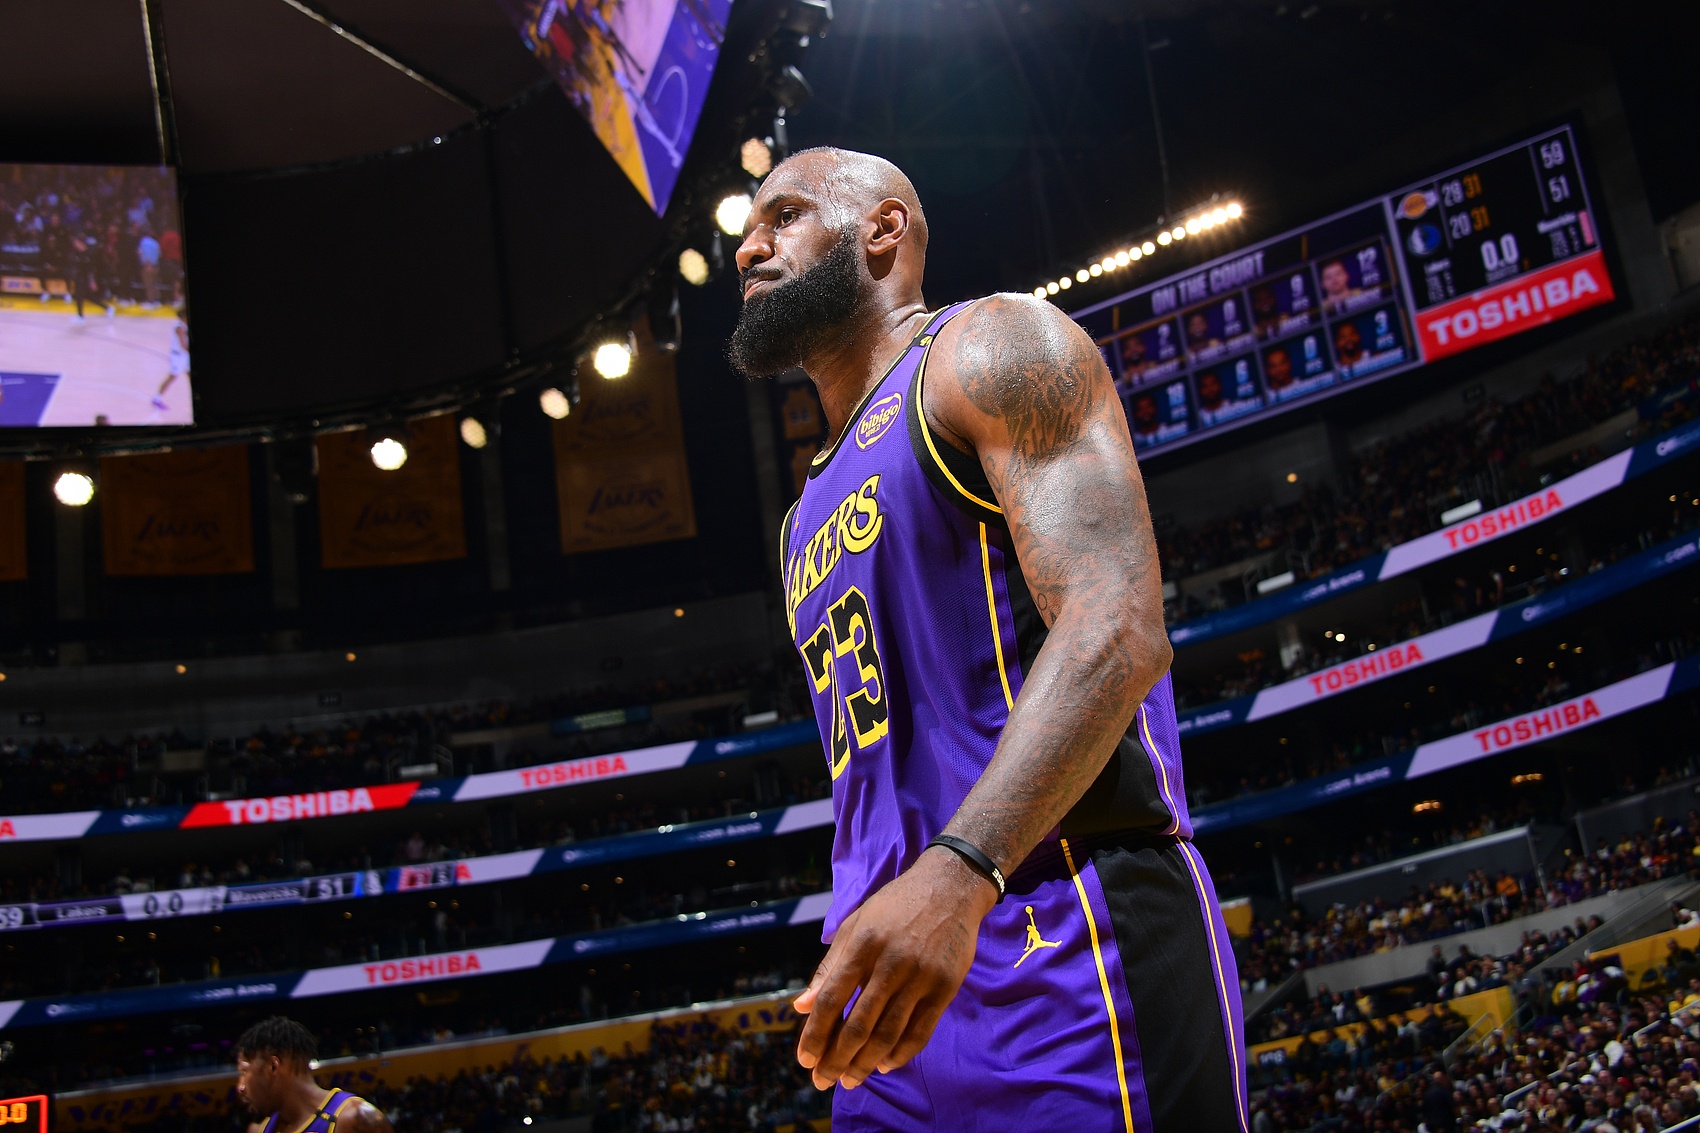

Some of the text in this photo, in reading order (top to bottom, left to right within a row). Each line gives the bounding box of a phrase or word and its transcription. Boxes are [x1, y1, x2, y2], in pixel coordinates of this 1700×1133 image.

[1549, 176, 1570, 202] 51
[1481, 233, 1519, 272] 0.0
[1427, 268, 1600, 346] TOSHIBA
[860, 404, 899, 435] bibigo
[1443, 489, 1563, 552] TOSHIBA
[799, 584, 889, 782] 23
[1308, 642, 1424, 697] TOSHIBA
[1474, 697, 1601, 753] TOSHIBA
[519, 755, 629, 789] TOSHIBA
[223, 787, 375, 825] TOSHIBA
[143, 891, 184, 916] 0.0
[317, 877, 345, 900] 51
[0, 905, 25, 930] 59
[57, 904, 108, 921] Lakers
[363, 952, 482, 985] TOSHIBA
